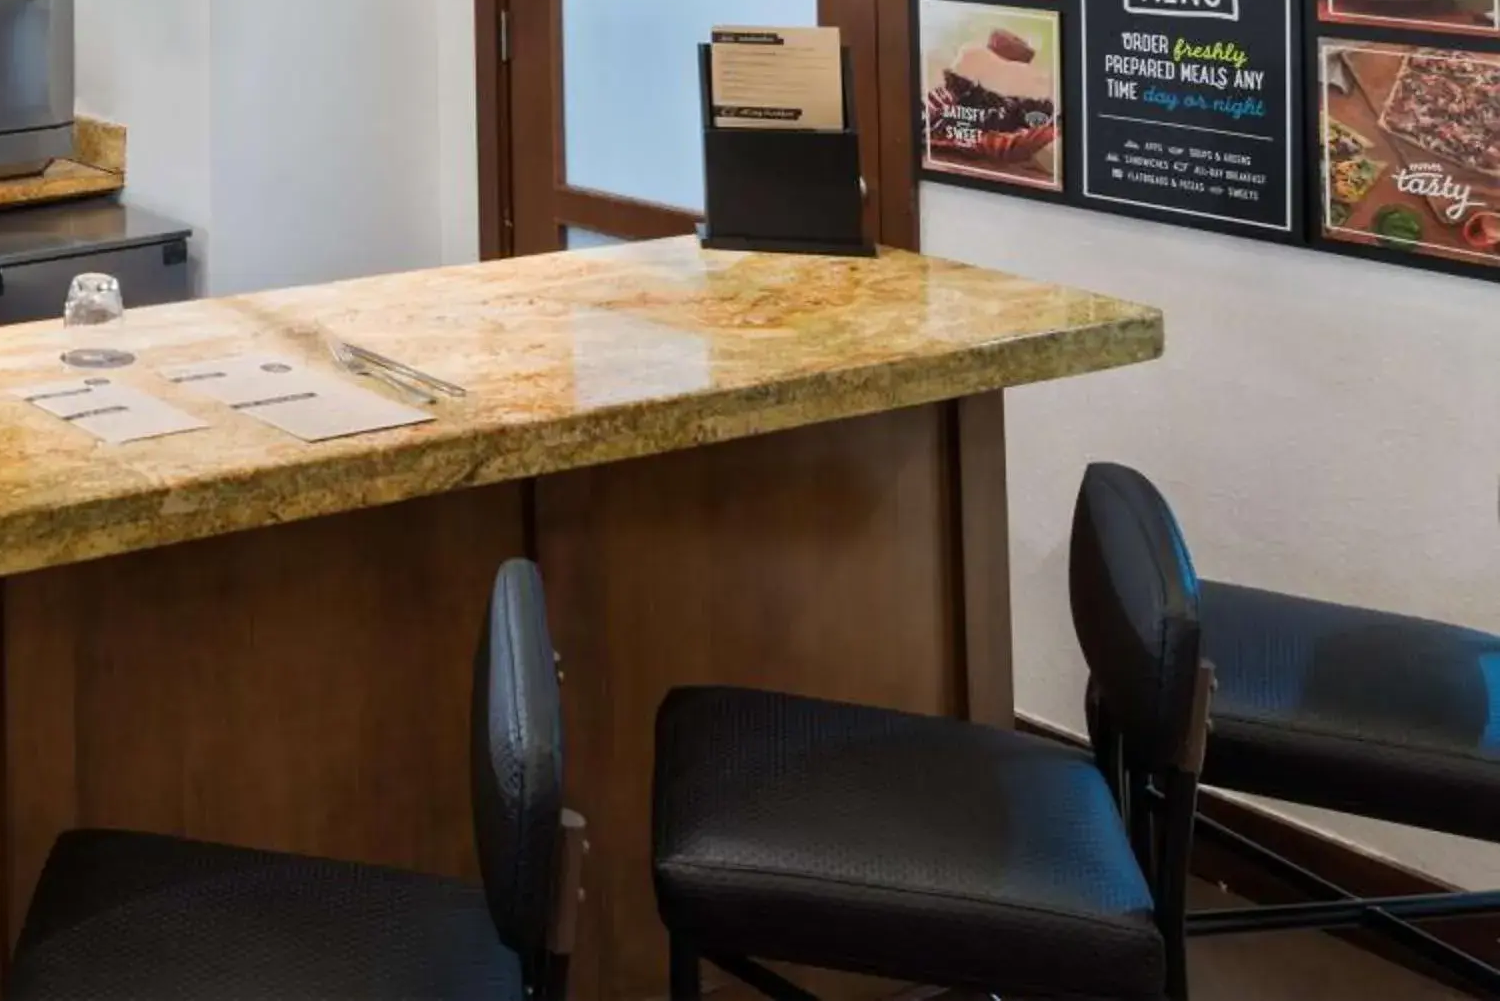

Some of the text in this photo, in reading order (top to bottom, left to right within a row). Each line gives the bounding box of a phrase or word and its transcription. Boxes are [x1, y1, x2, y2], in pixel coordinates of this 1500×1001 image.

[1121, 32, 1248, 67] ORDER freshly
[1105, 54, 1265, 90] PREPARED MEALS ANY
[1106, 78, 1266, 119] TIME day or night
[1390, 168, 1487, 219] tasty
